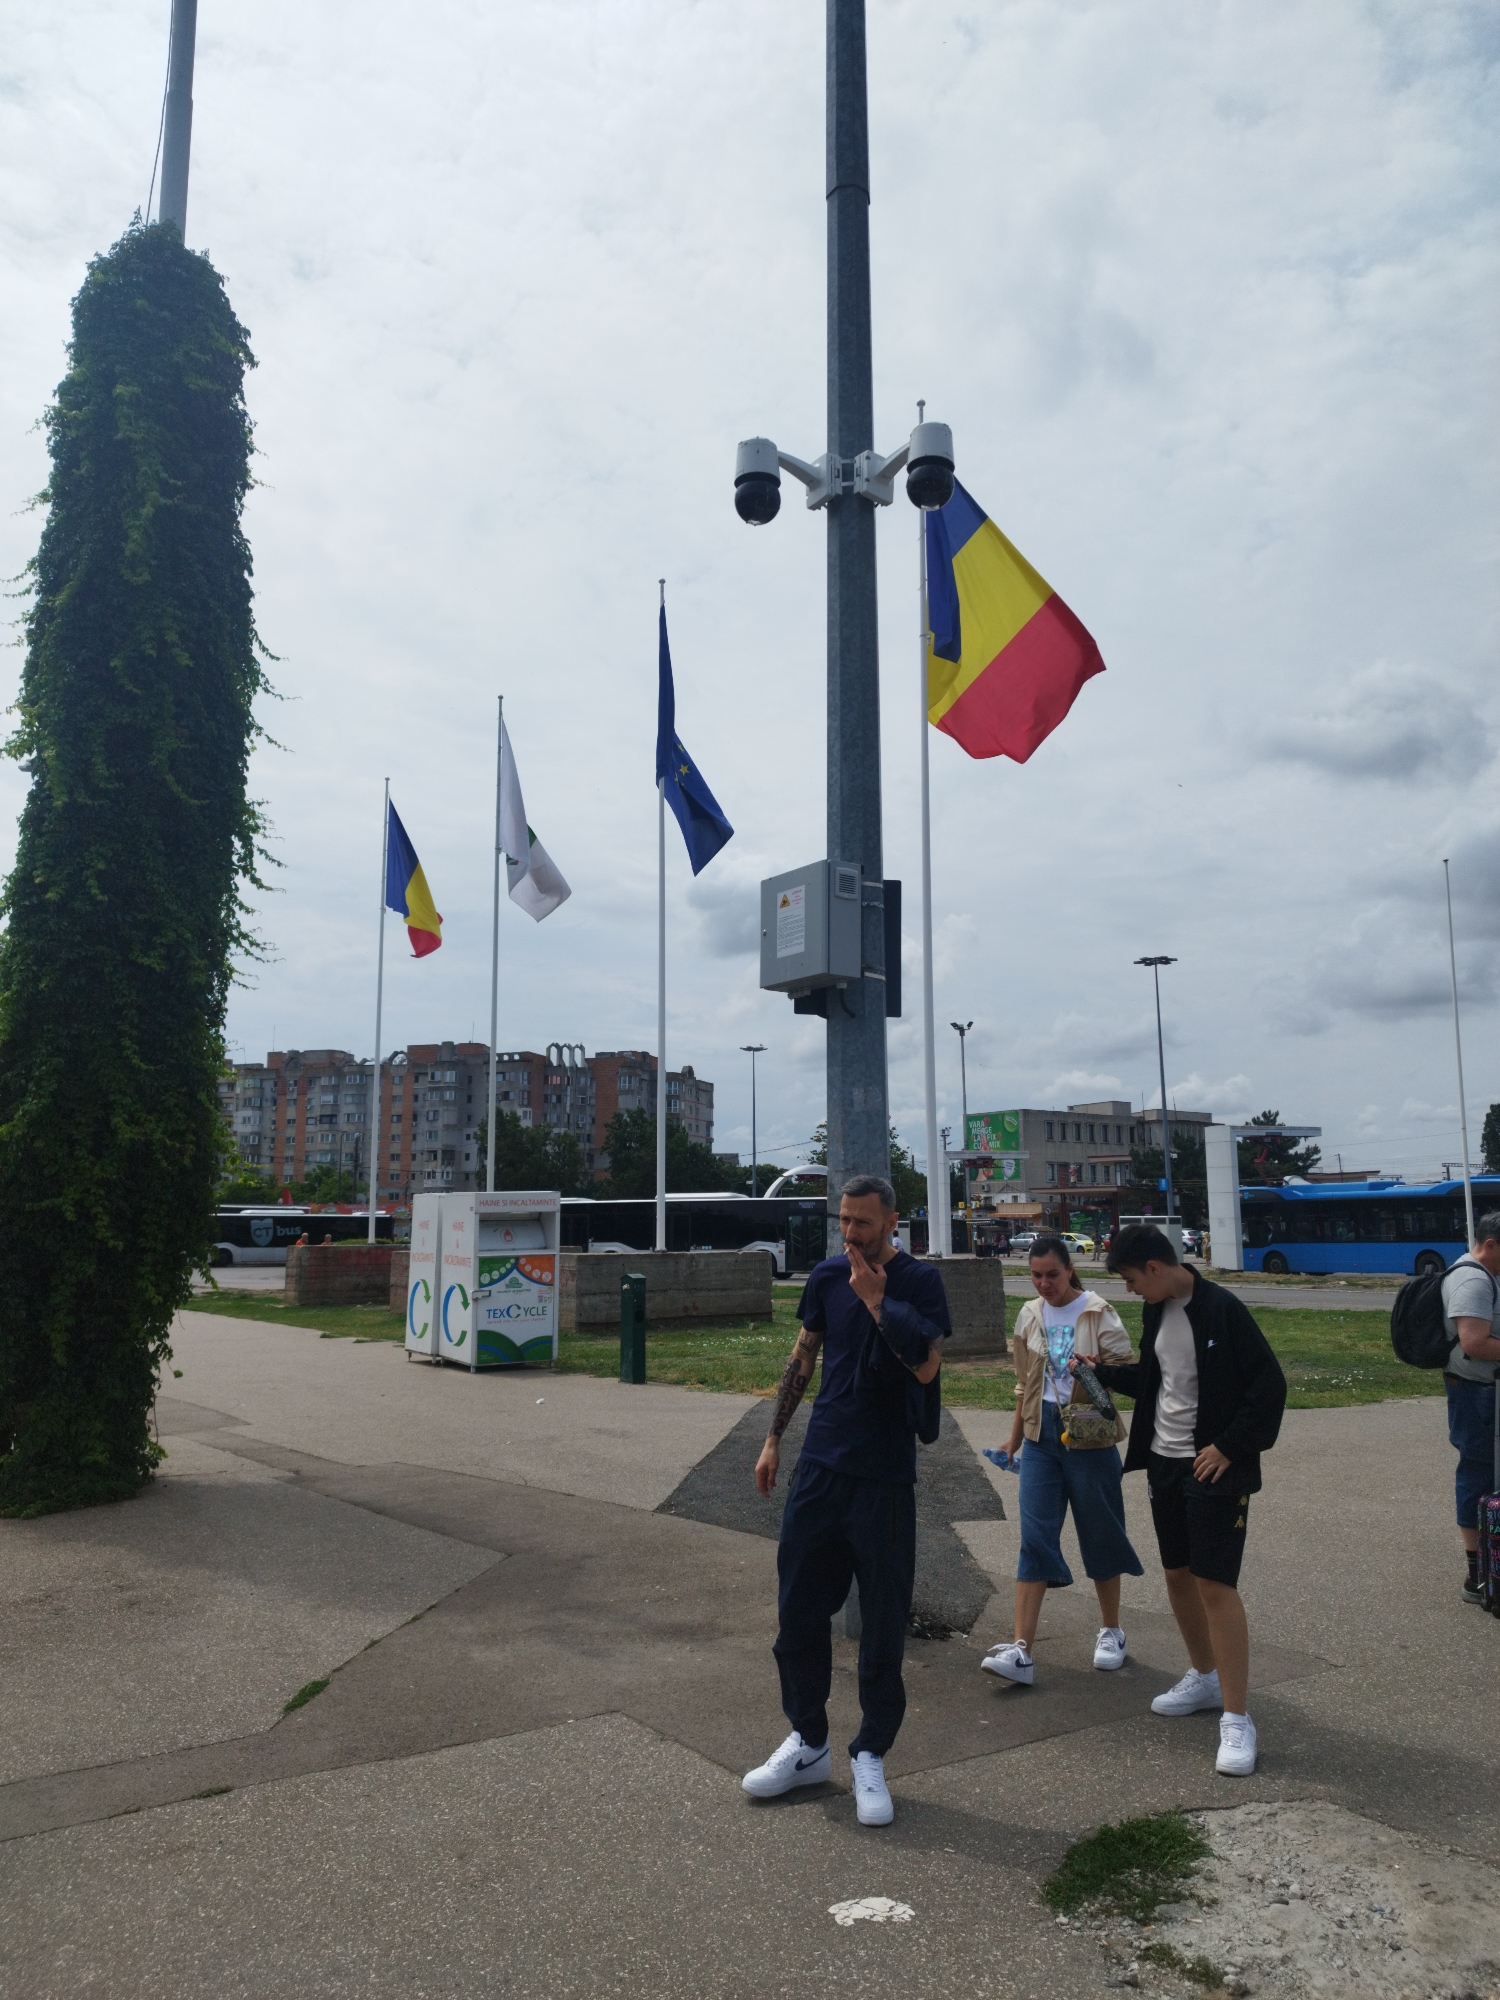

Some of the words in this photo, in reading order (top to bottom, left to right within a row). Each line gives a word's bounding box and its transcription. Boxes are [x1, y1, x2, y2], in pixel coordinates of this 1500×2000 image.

[969, 1120, 985, 1128] VARA
[972, 1127, 992, 1135] MERGE
[479, 1199, 500, 1207] HAINE
[509, 1198, 557, 1207] INCALTAMINTE
[253, 1227, 272, 1237] CT
[275, 1225, 301, 1236] bus
